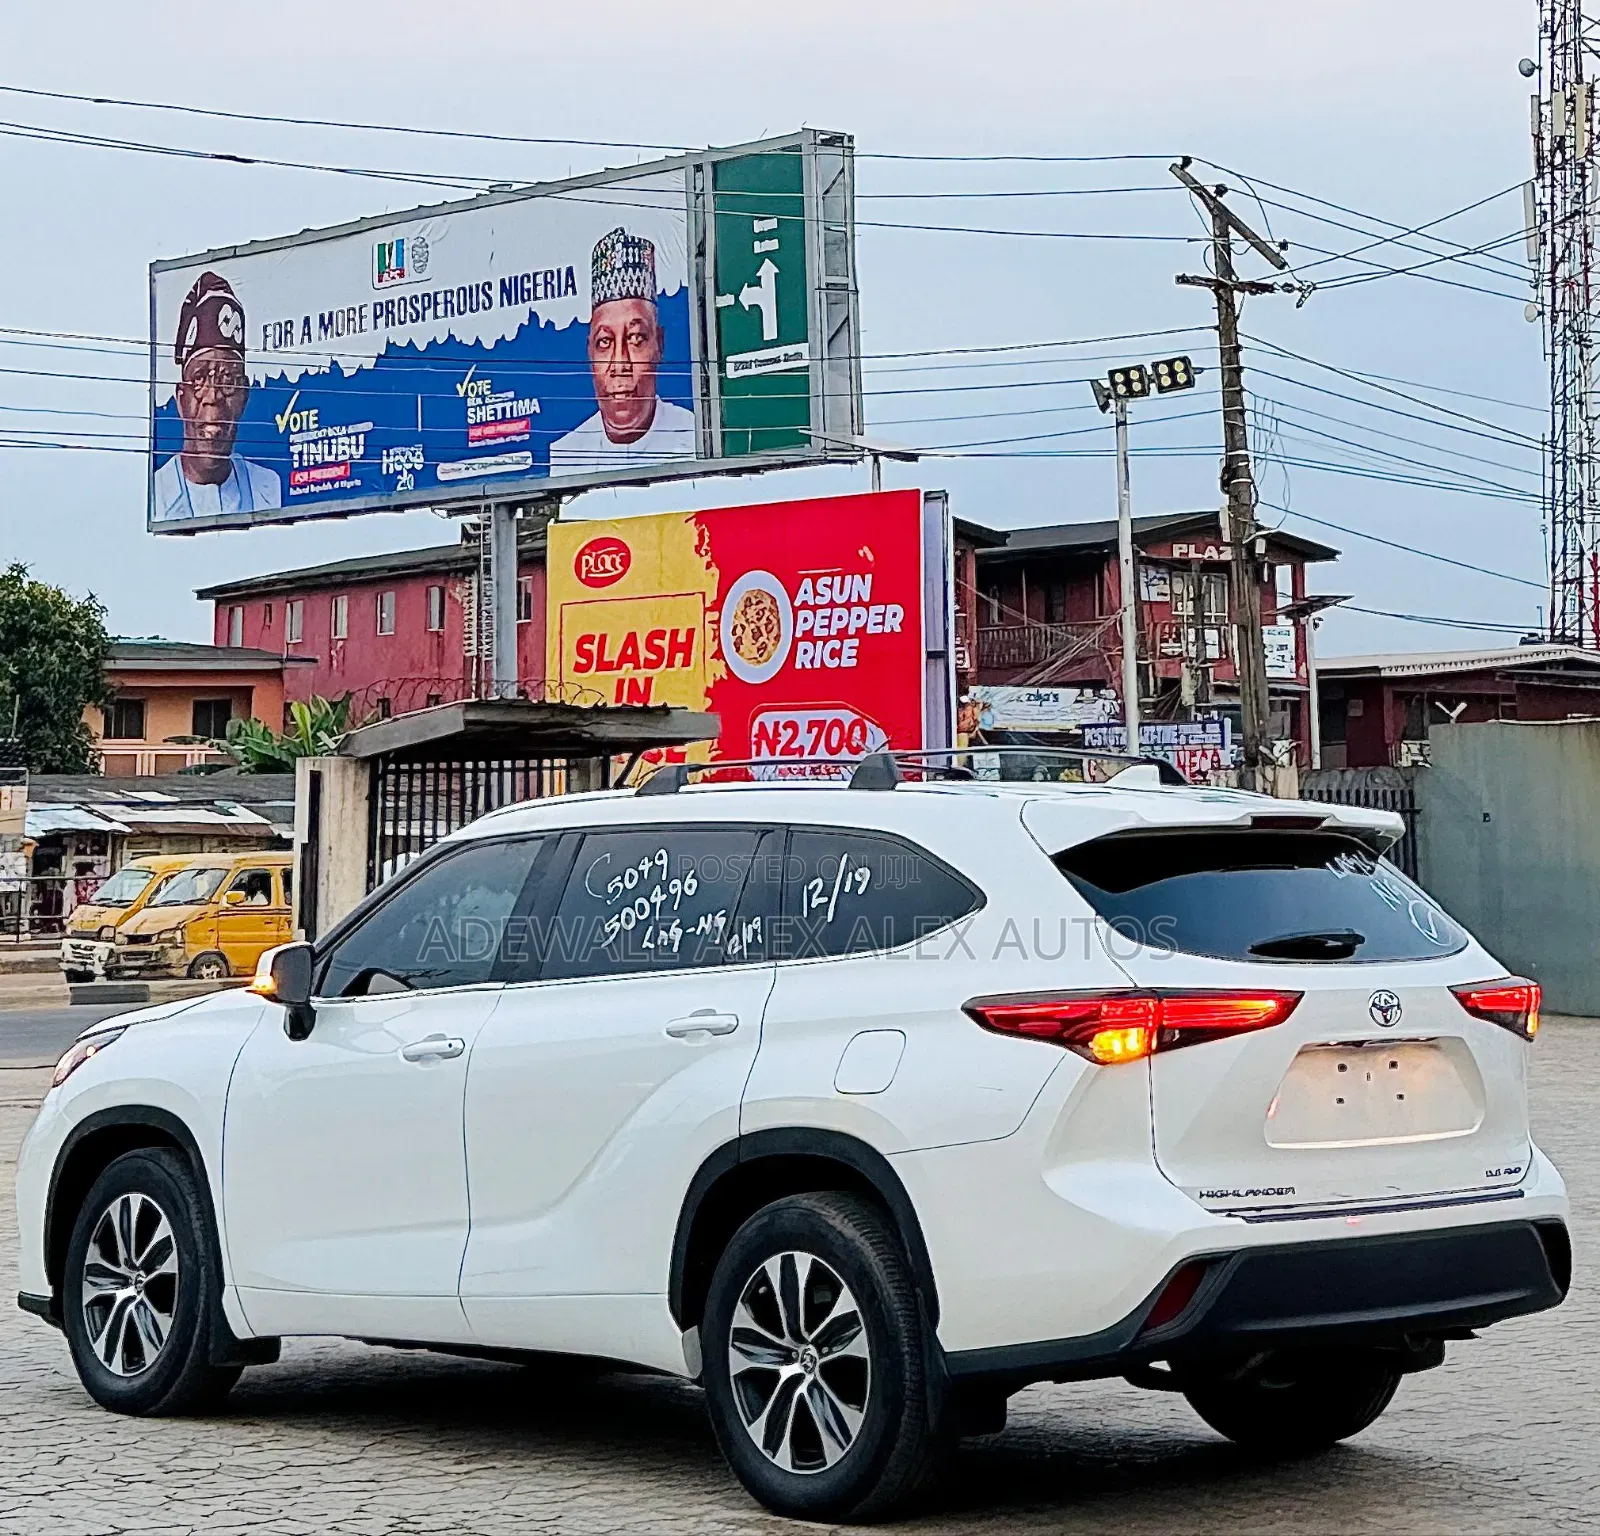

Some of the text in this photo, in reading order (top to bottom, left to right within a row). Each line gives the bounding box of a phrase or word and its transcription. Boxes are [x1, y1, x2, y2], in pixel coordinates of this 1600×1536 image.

[262, 265, 578, 351] FOR A MORE PROSPEROUS NIGERIA
[467, 398, 541, 424] SHETTIMA
[289, 433, 365, 468] TINUBU
[1172, 543, 1233, 560] PLAZ
[794, 574, 873, 607] ASUN
[794, 604, 905, 638] PEPPER
[573, 628, 696, 674] SLASH
[794, 639, 860, 670] RICE
[614, 676, 654, 706] IN
[803, 853, 871, 922] 12/19
[601, 869, 698, 948] 500496
